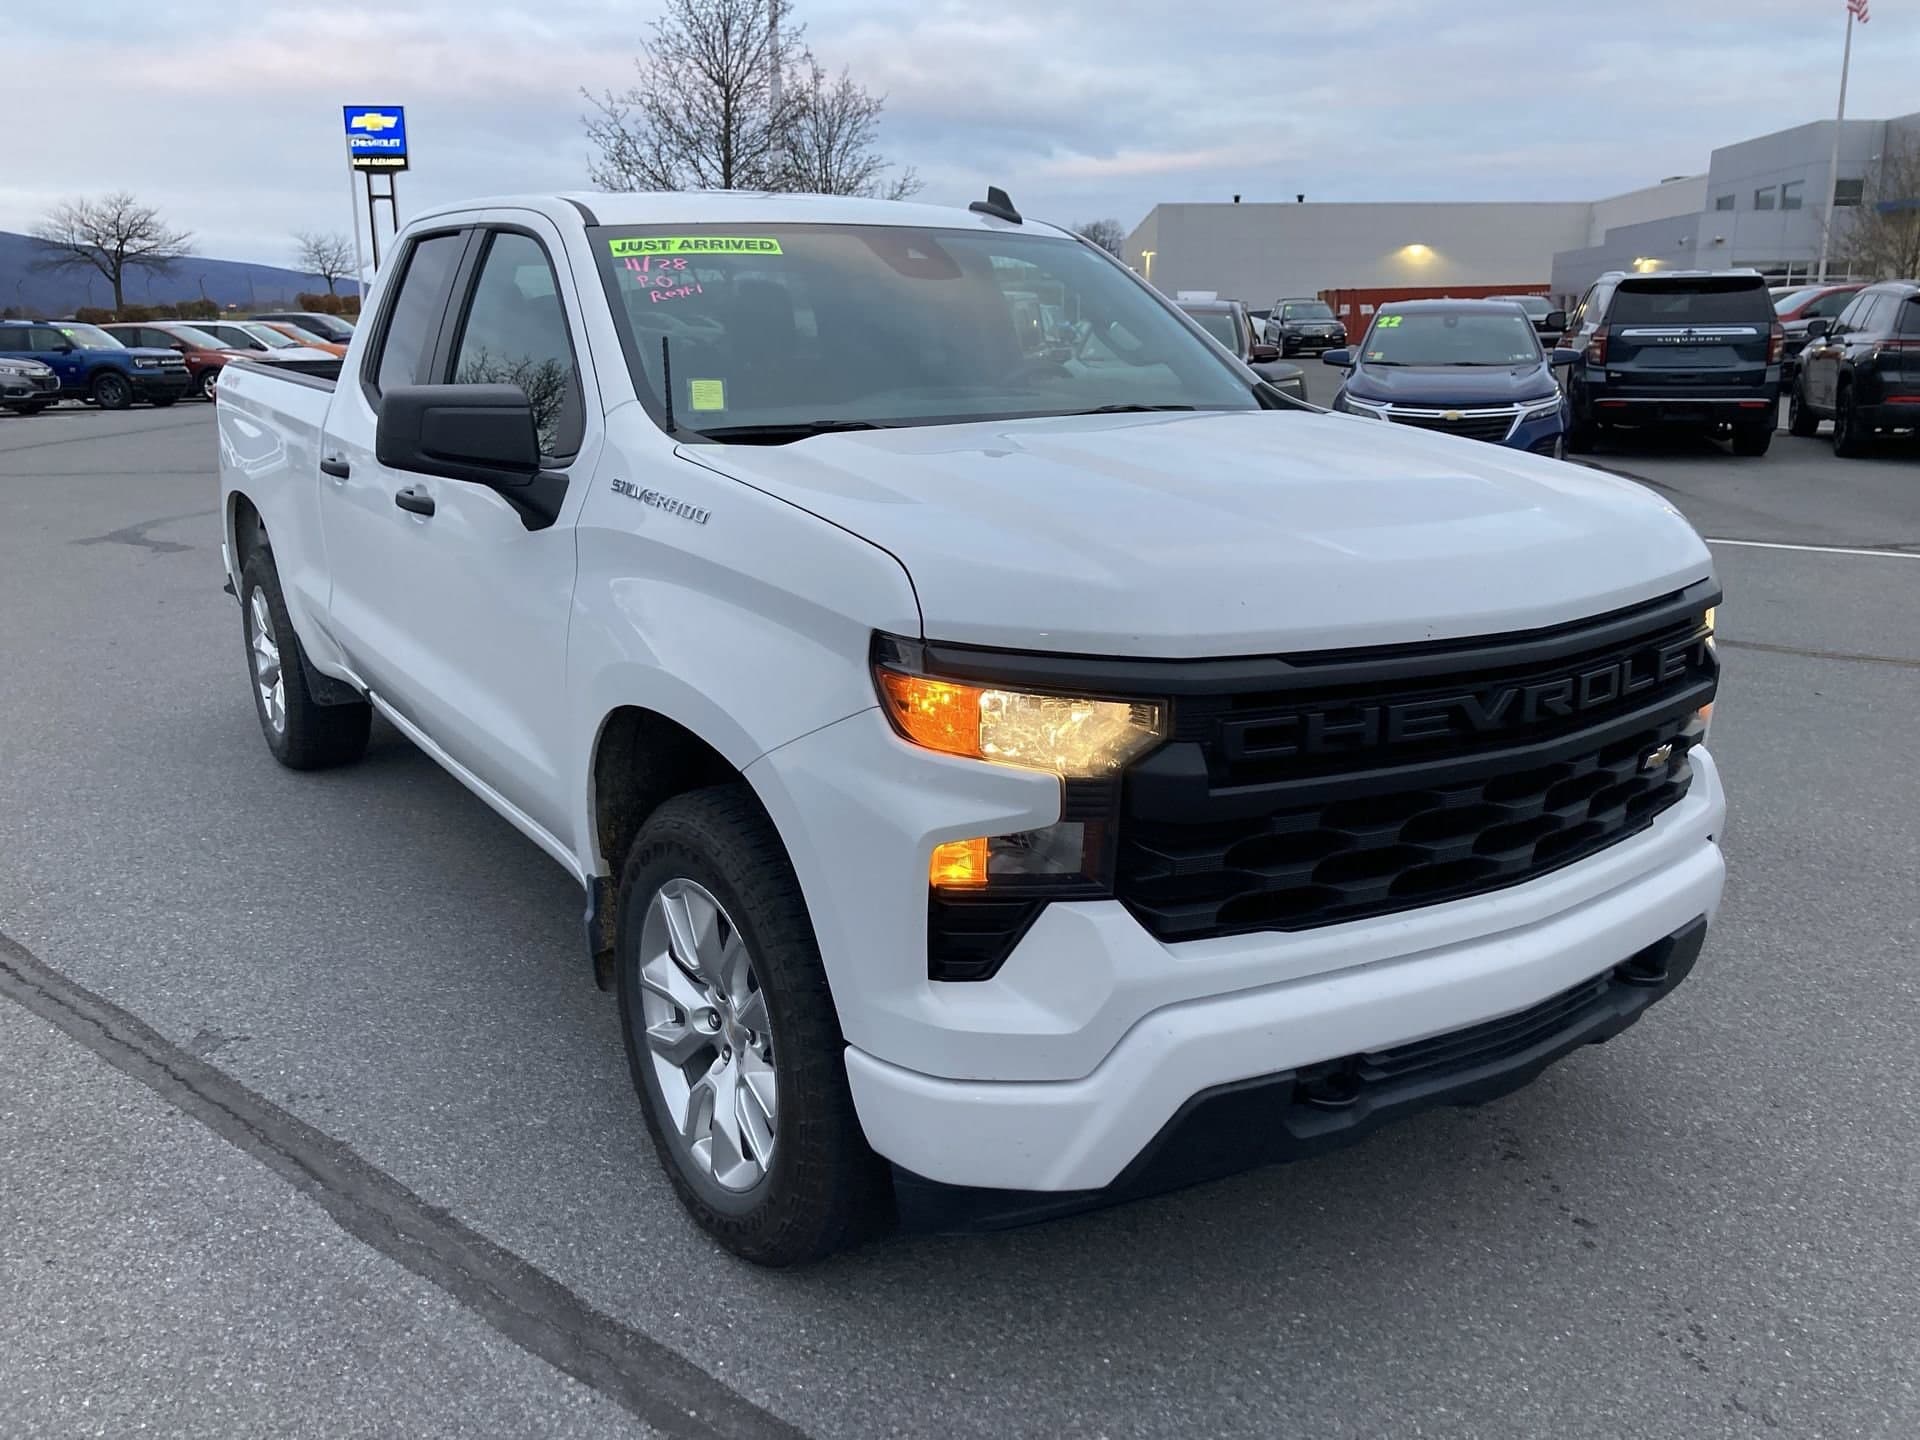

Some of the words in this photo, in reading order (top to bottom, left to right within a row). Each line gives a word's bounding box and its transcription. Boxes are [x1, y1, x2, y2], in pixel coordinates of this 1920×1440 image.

[351, 138, 400, 147] CHEVROLET
[614, 240, 673, 253] JUST
[678, 239, 778, 251] ARRIVED
[1377, 316, 1402, 328] 22
[610, 478, 712, 525] SILVERADO
